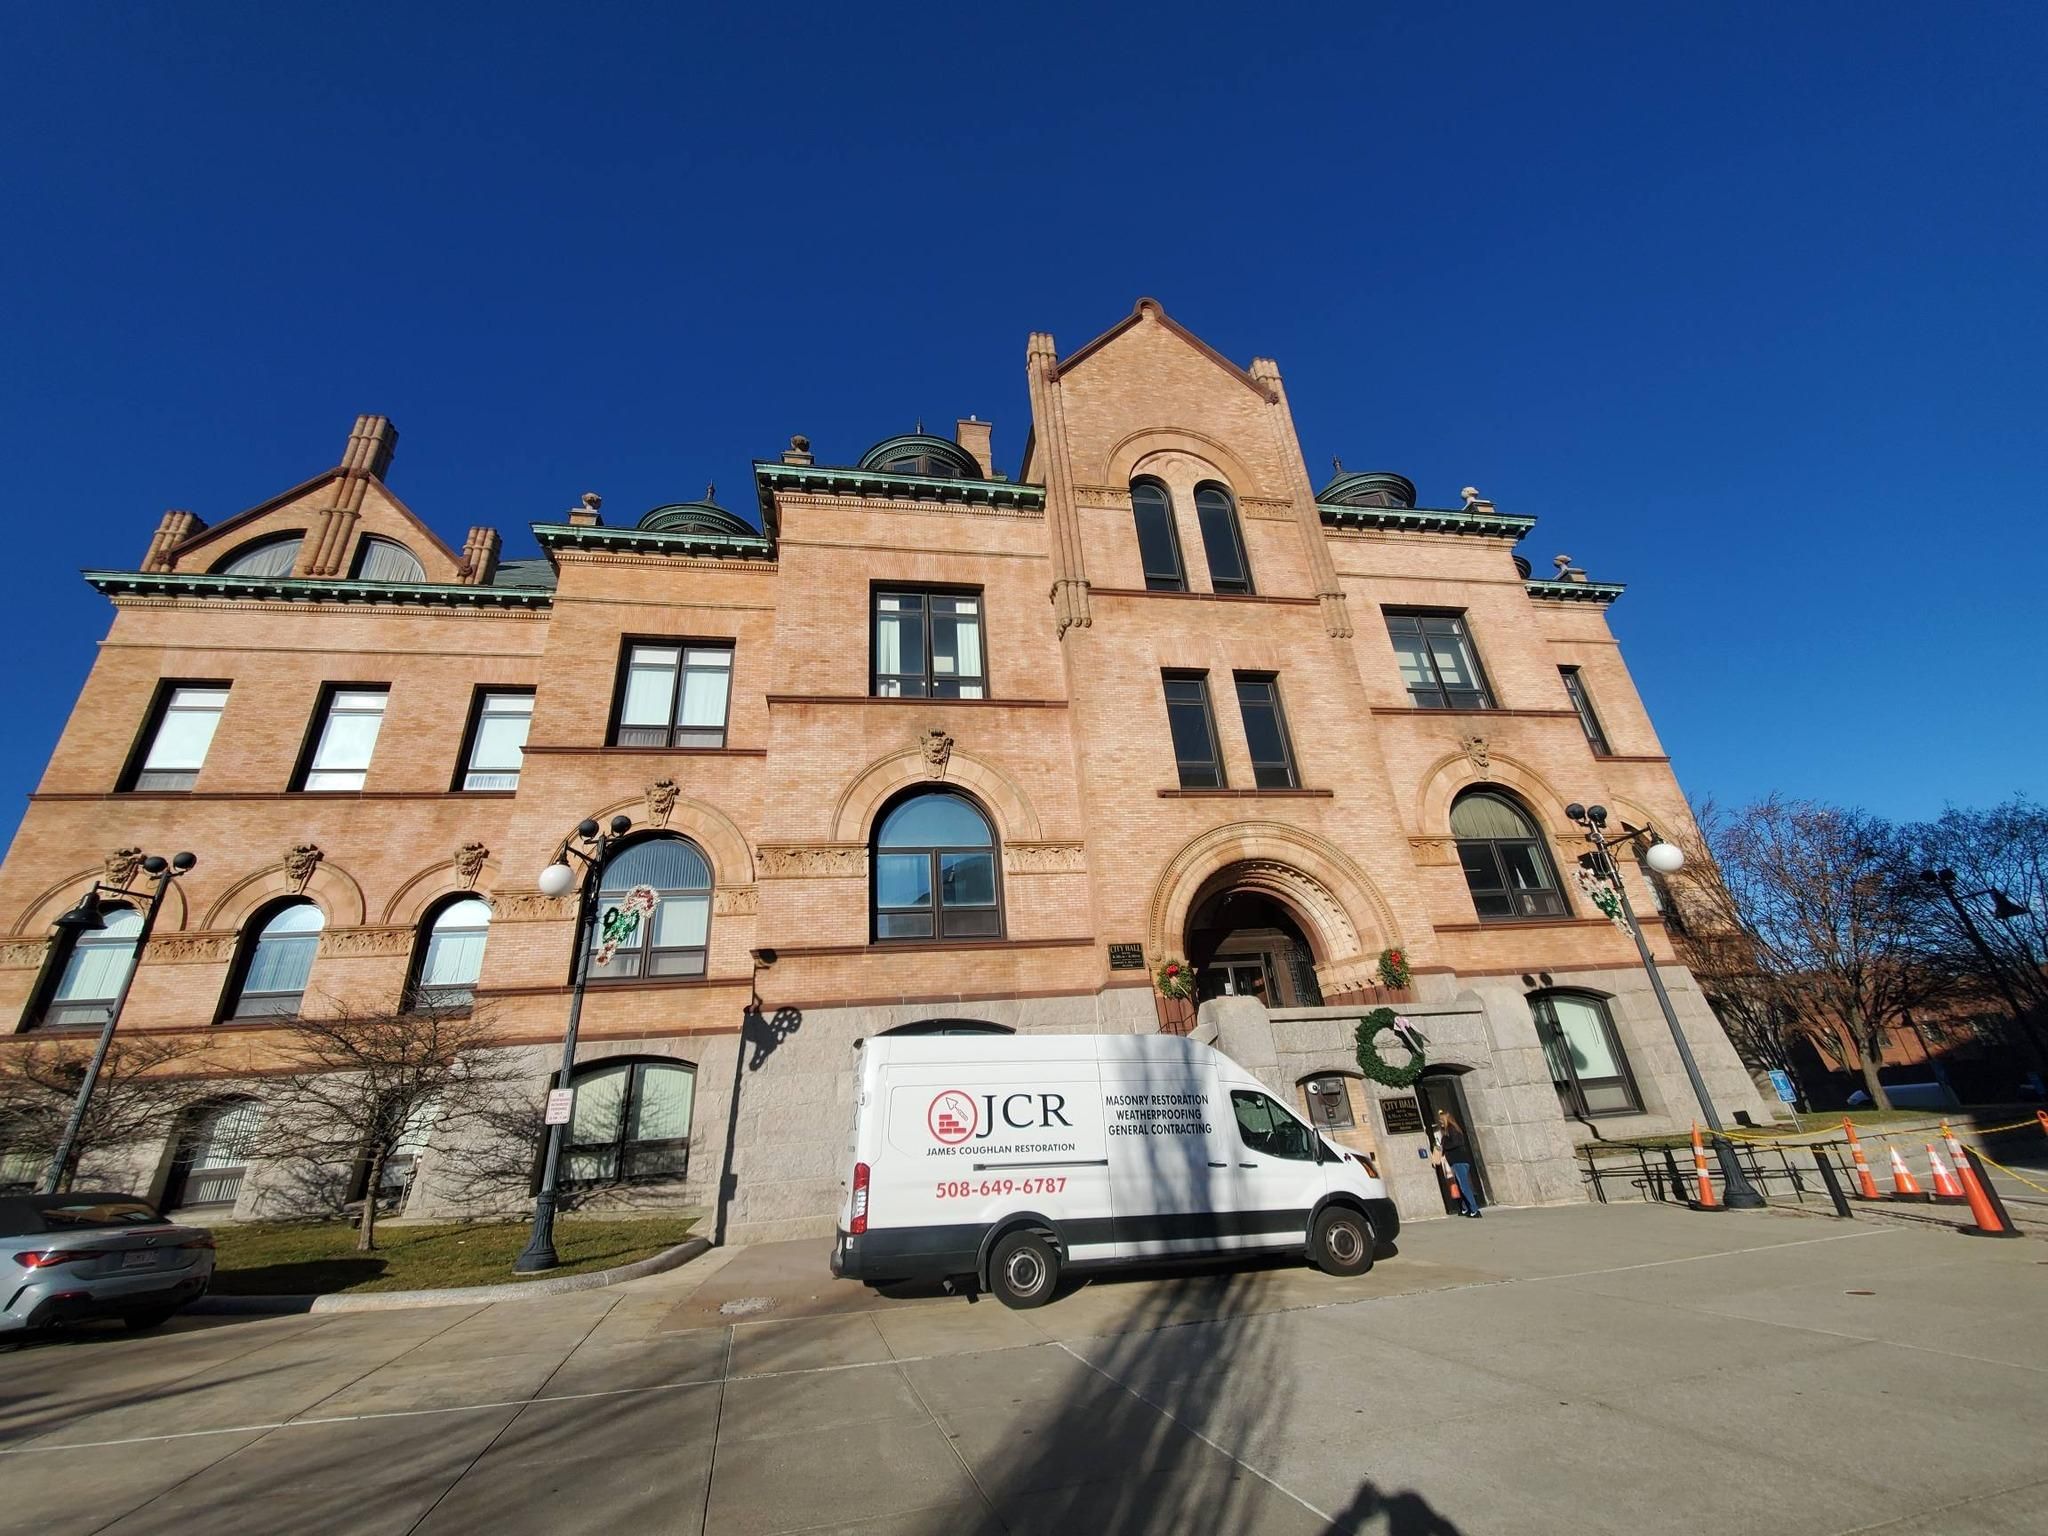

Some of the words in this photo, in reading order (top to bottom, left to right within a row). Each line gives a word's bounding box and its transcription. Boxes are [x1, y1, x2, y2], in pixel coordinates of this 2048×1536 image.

[1110, 945, 1124, 953] CITY
[1125, 944, 1141, 952] HALL
[1106, 1095, 1149, 1106] MASONRY
[1151, 1094, 1209, 1105] RESTORATION
[976, 1093, 1073, 1139] JCR
[1116, 1109, 1202, 1120] WEATHERPROOFING
[1108, 1124, 1149, 1136] GENERAL
[1151, 1123, 1212, 1135] CONTRACTING
[927, 1146, 956, 1156] JAMES
[959, 1145, 1012, 1155] COUGHLAN
[1015, 1143, 1075, 1153] RESTORATION
[936, 1177, 1067, 1199] 508-649-6787
